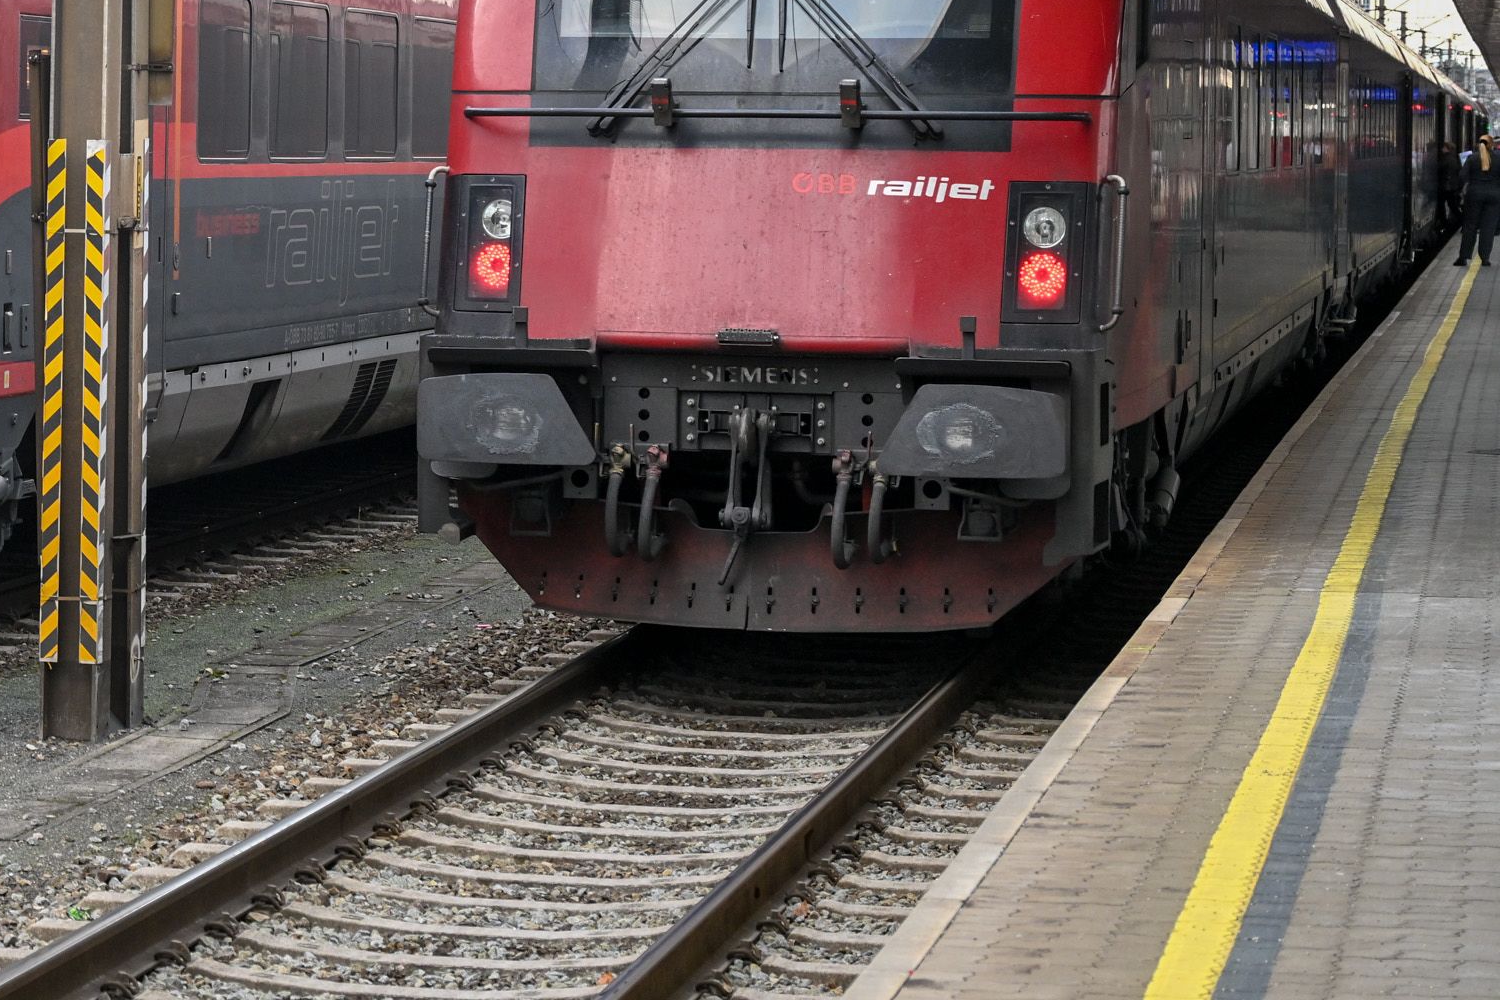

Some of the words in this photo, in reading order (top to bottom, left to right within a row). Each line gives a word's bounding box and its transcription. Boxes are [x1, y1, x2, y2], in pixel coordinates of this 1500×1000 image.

[791, 171, 856, 195] ÖBB
[867, 175, 996, 203] railjet
[265, 179, 399, 307] railjet
[700, 365, 808, 385] SIEMENS
